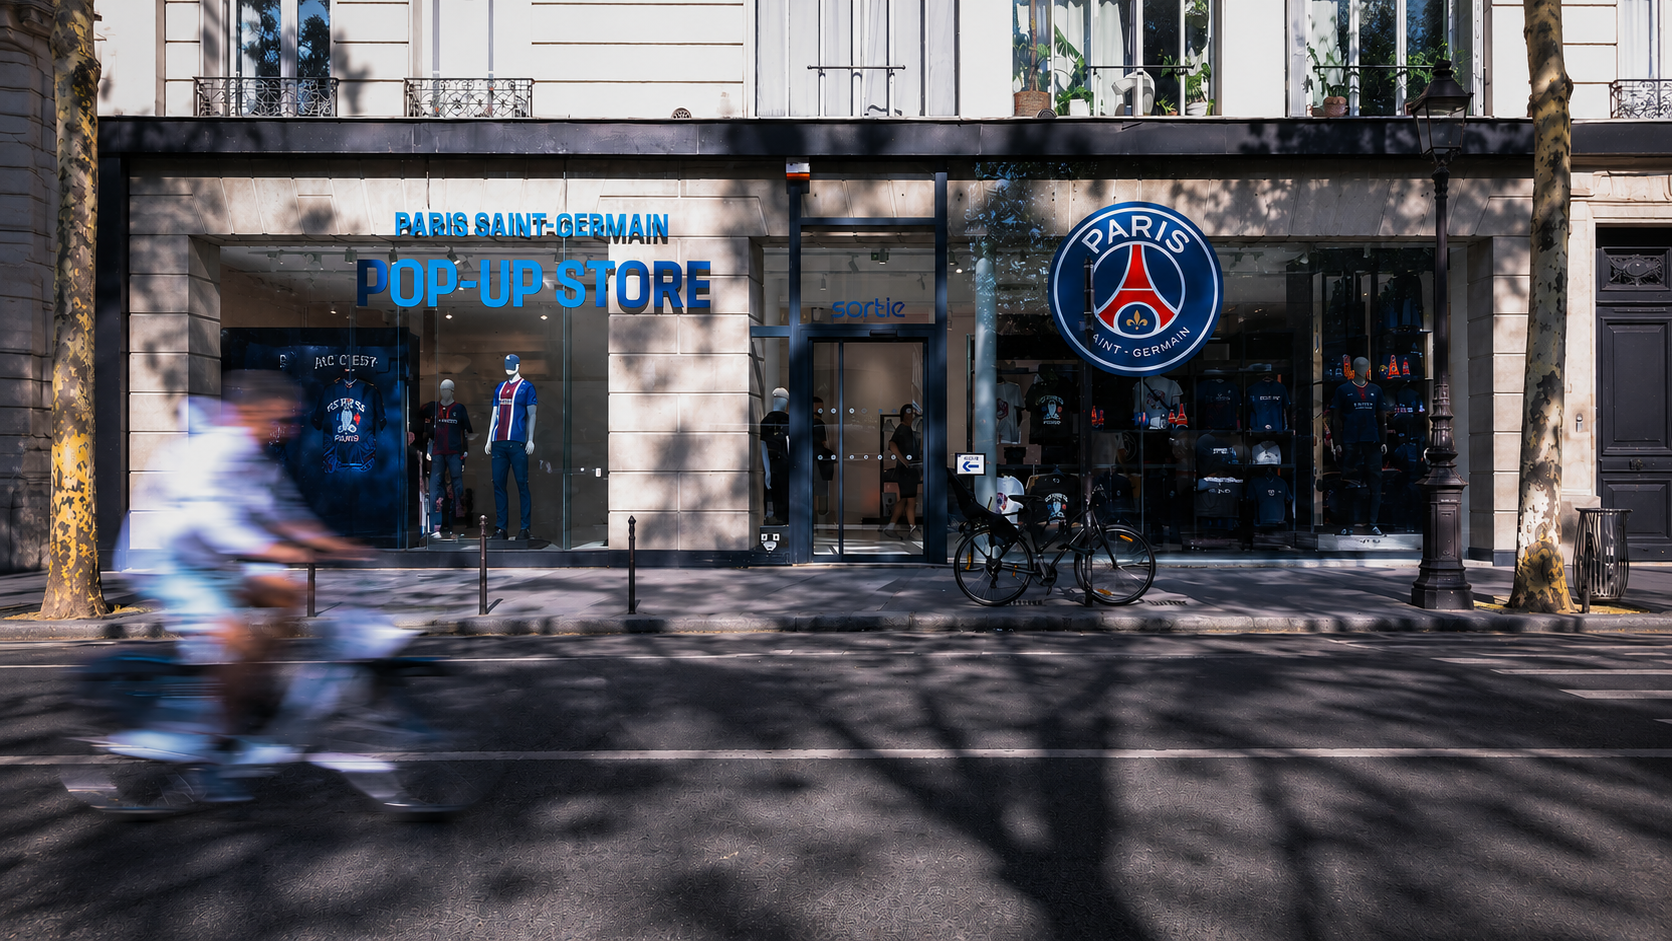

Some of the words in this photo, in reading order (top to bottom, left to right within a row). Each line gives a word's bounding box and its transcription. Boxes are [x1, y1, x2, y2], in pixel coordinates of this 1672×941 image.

[395, 212, 469, 237] PARIS
[474, 213, 669, 238] SAINT-GERMAIN
[1081, 215, 1190, 254] PARIS
[356, 259, 543, 308] POP-UP
[555, 260, 711, 309] STORE
[832, 297, 906, 318] sortie
[1092, 333, 1122, 354] AINT
[1132, 326, 1190, 357] GERMAIN
